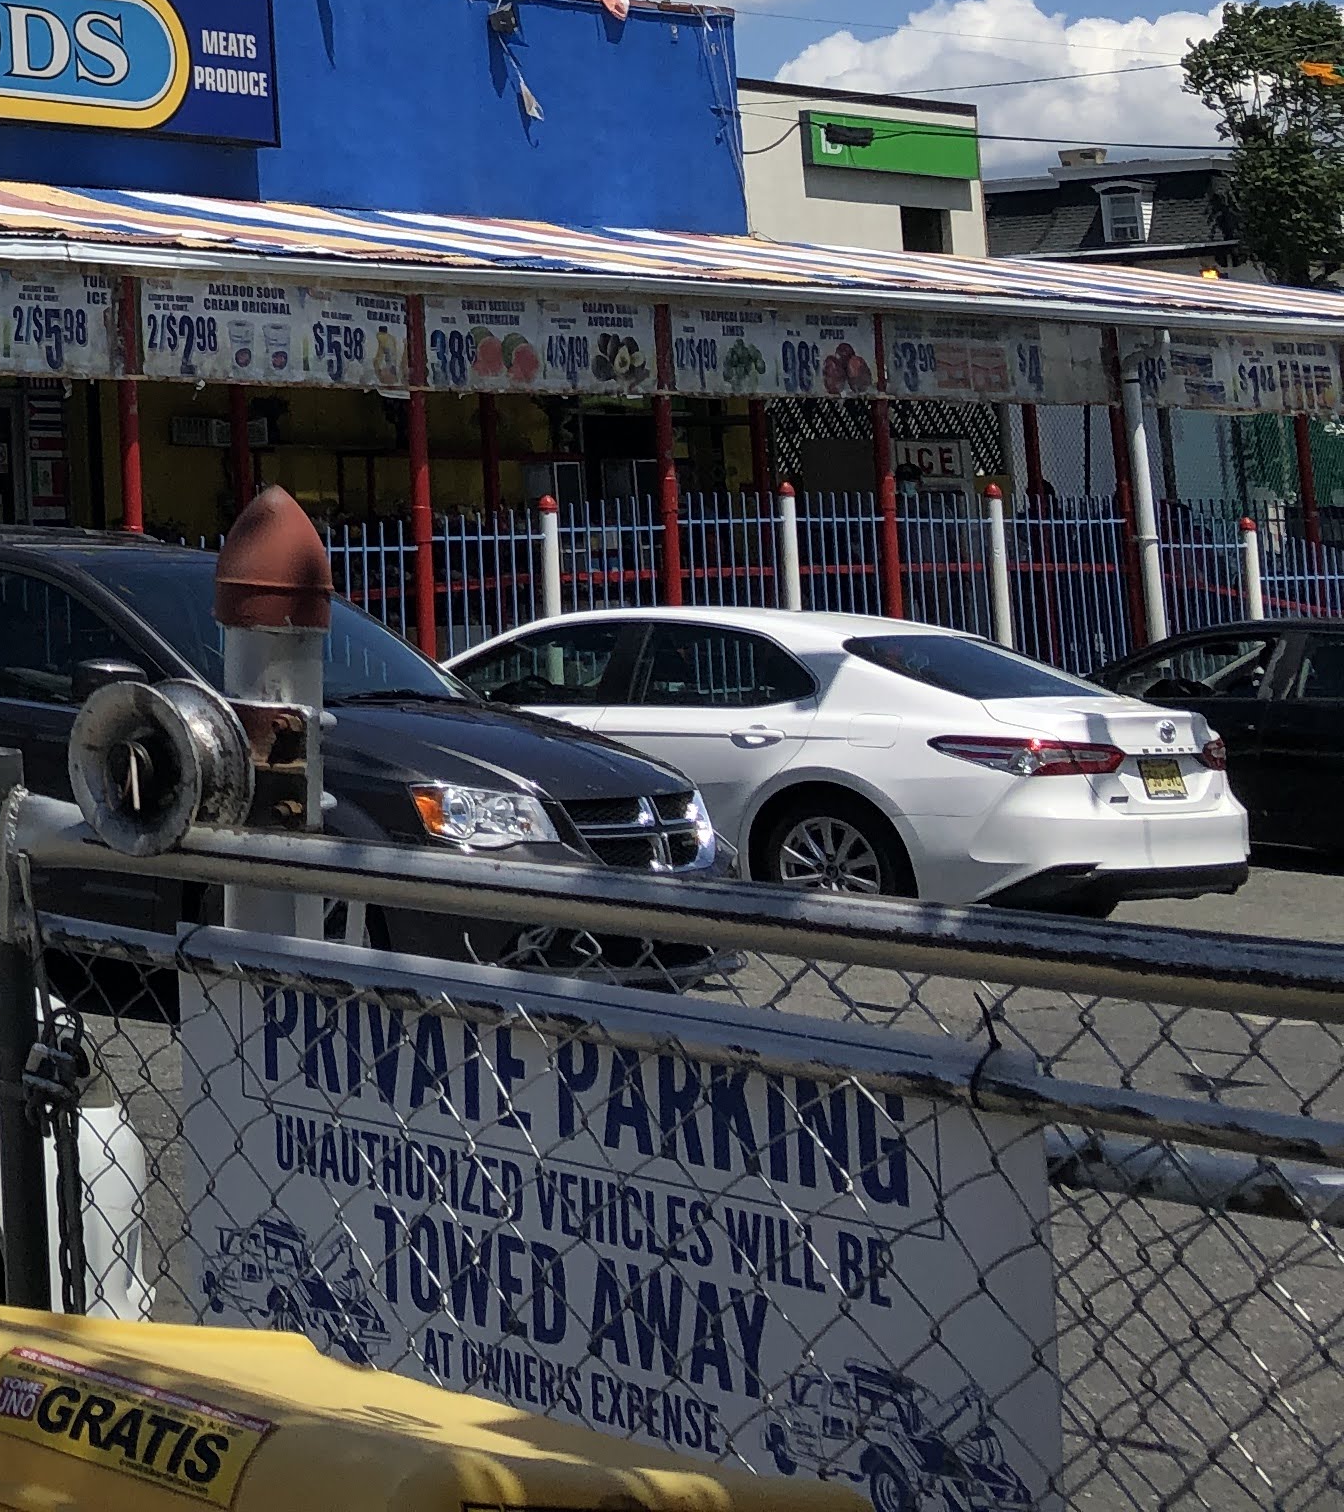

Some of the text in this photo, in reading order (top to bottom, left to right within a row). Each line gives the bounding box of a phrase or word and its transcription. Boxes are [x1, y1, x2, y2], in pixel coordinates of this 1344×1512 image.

[202, 29, 256, 58] MEATS
[194, 65, 267, 97] PRODUCE
[87, 291, 108, 305] ICE
[204, 298, 239, 312] CREAM
[242, 300, 291, 315] ORIGINAL
[209, 284, 253, 299] AXELROD
[256, 286, 285, 300] SOUR
[13, 305, 87, 369] 2/$598
[147, 312, 218, 375] 2/$298
[313, 321, 365, 381] $598
[904, 446, 955, 474] ICE
[263, 985, 910, 1207] PRIVATE PARKING
[274, 1113, 892, 1308] UNAUTHORIZED VEHICLES WILL BE
[373, 1205, 772, 1398] TOWED AWAY
[2, 1377, 46, 1394] TOME
[423, 1325, 456, 1376] AT
[591, 1372, 721, 1458] EXPENSE
[37, 1386, 229, 1483] GRATIS
